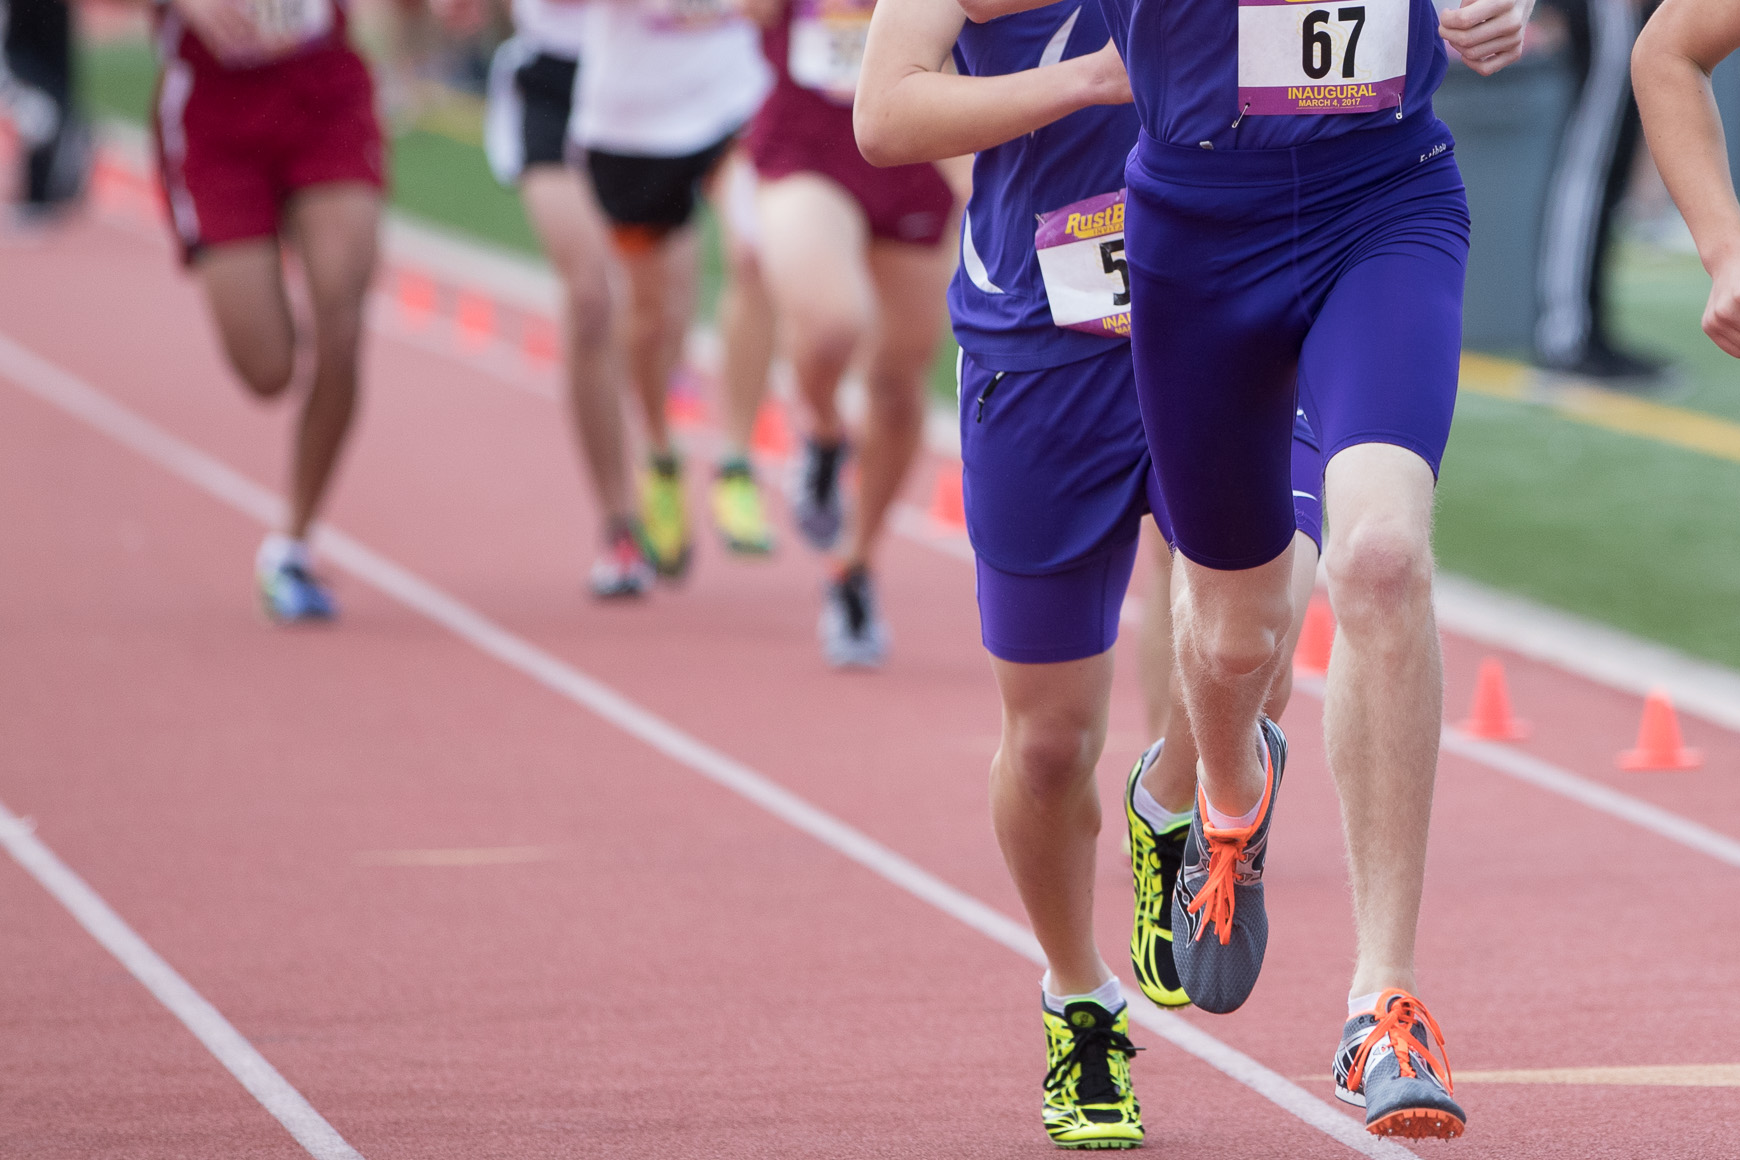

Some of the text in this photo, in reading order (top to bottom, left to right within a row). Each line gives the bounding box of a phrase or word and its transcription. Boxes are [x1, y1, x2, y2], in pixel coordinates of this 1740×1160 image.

[1302, 6, 1366, 80] 67
[1287, 84, 1377, 100] INAUGURAL
[1298, 98, 1331, 107] MARCH
[1332, 99, 1340, 108] 4,
[1341, 97, 1361, 106] 2017
